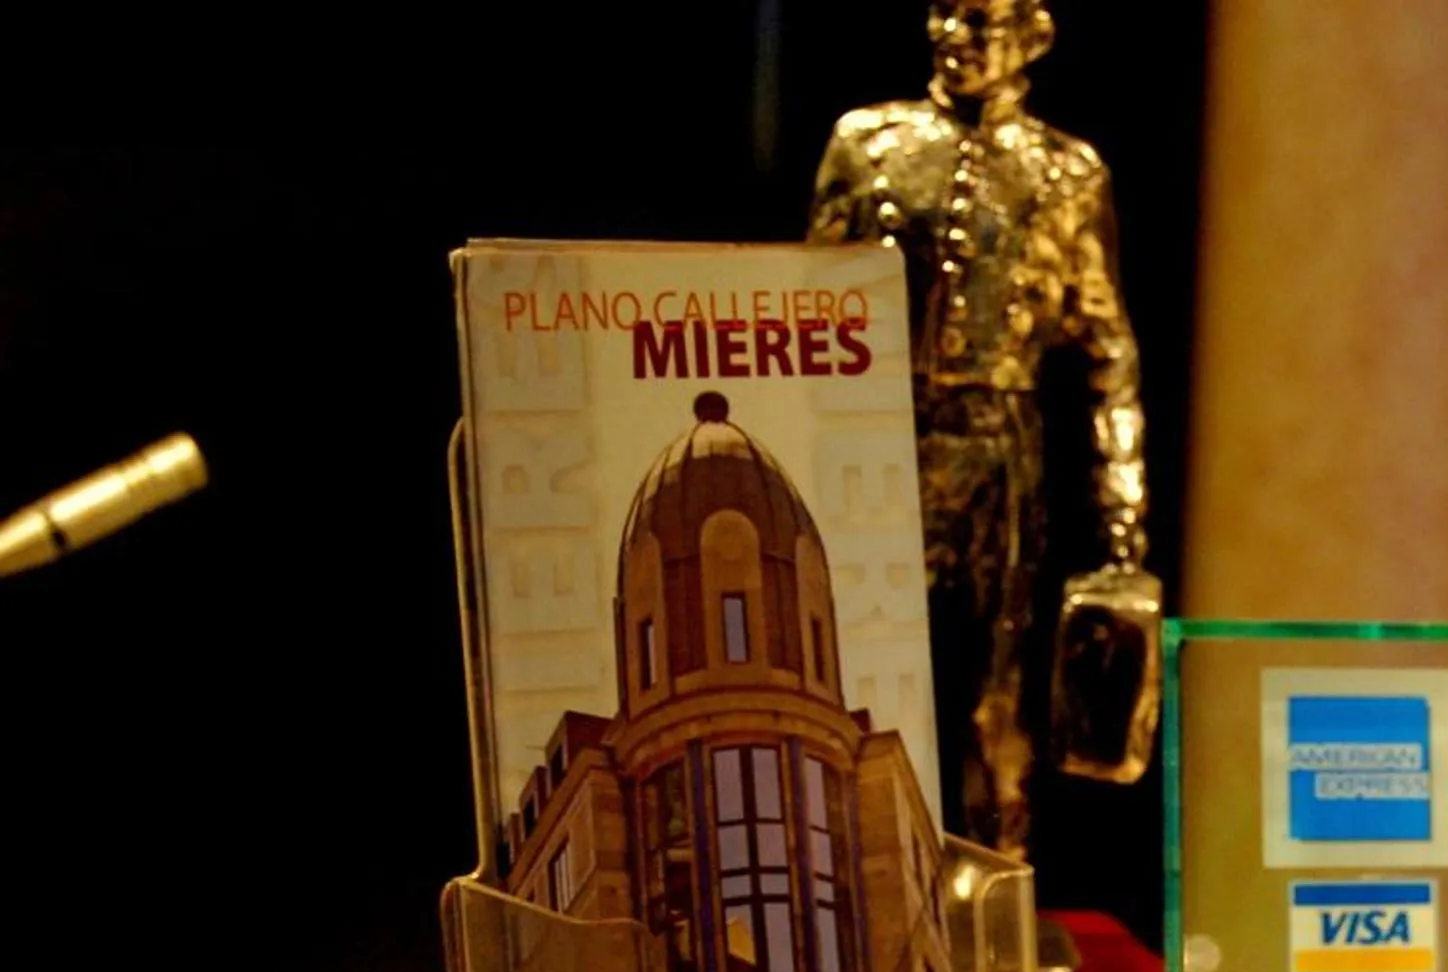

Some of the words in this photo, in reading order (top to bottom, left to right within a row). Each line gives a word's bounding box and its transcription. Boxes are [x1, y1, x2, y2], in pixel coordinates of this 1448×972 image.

[503, 290, 642, 333] PLANO
[653, 286, 869, 331] CALLEJERO
[632, 317, 873, 380] MIERES
[1319, 910, 1412, 946] VISA
